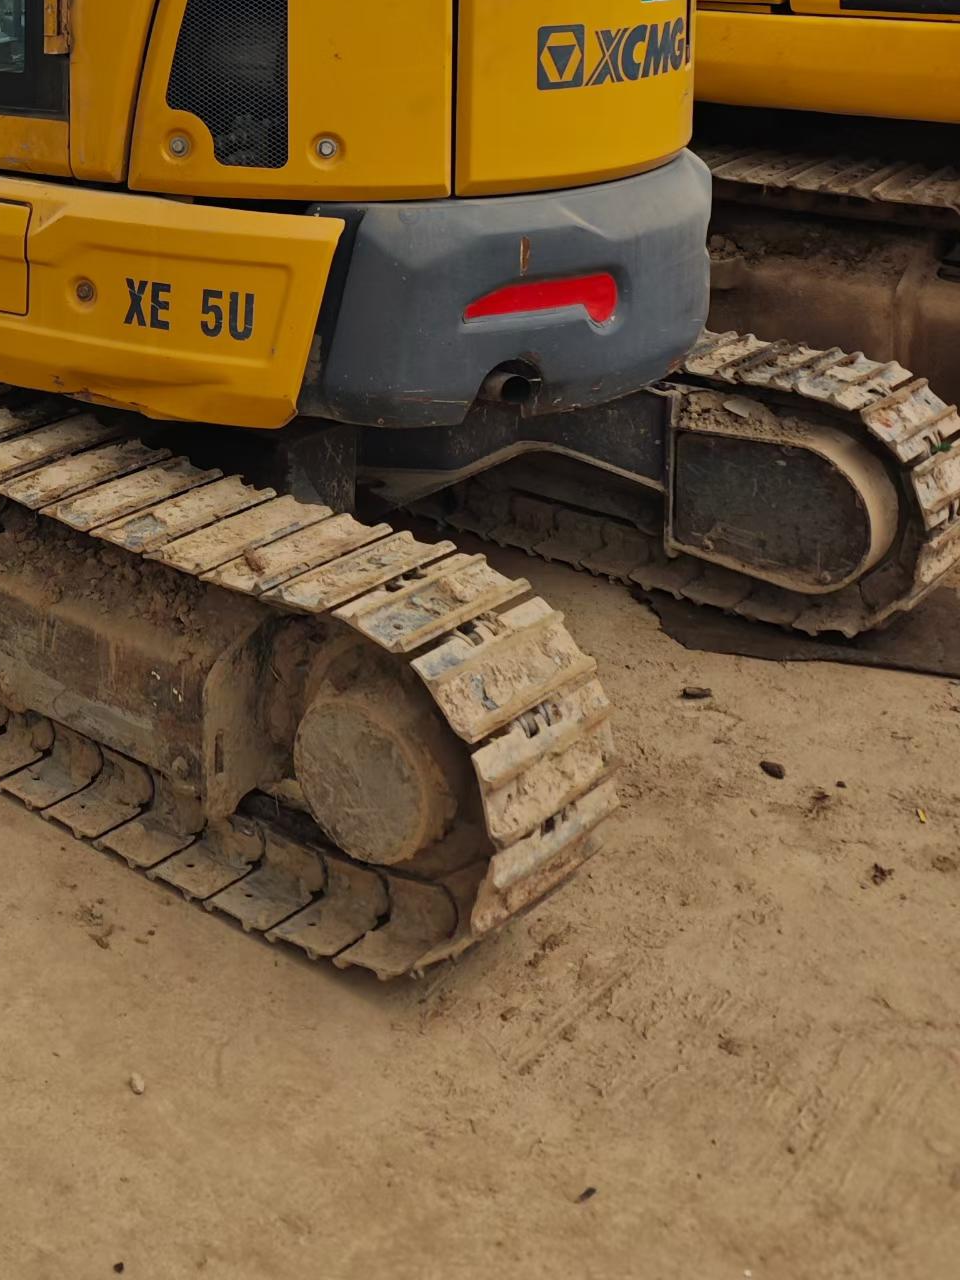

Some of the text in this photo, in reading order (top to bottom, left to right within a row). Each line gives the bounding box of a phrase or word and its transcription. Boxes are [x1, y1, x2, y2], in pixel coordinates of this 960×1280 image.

[584, 17, 686, 87] XCMG
[123, 277, 255, 341] XE 5U
